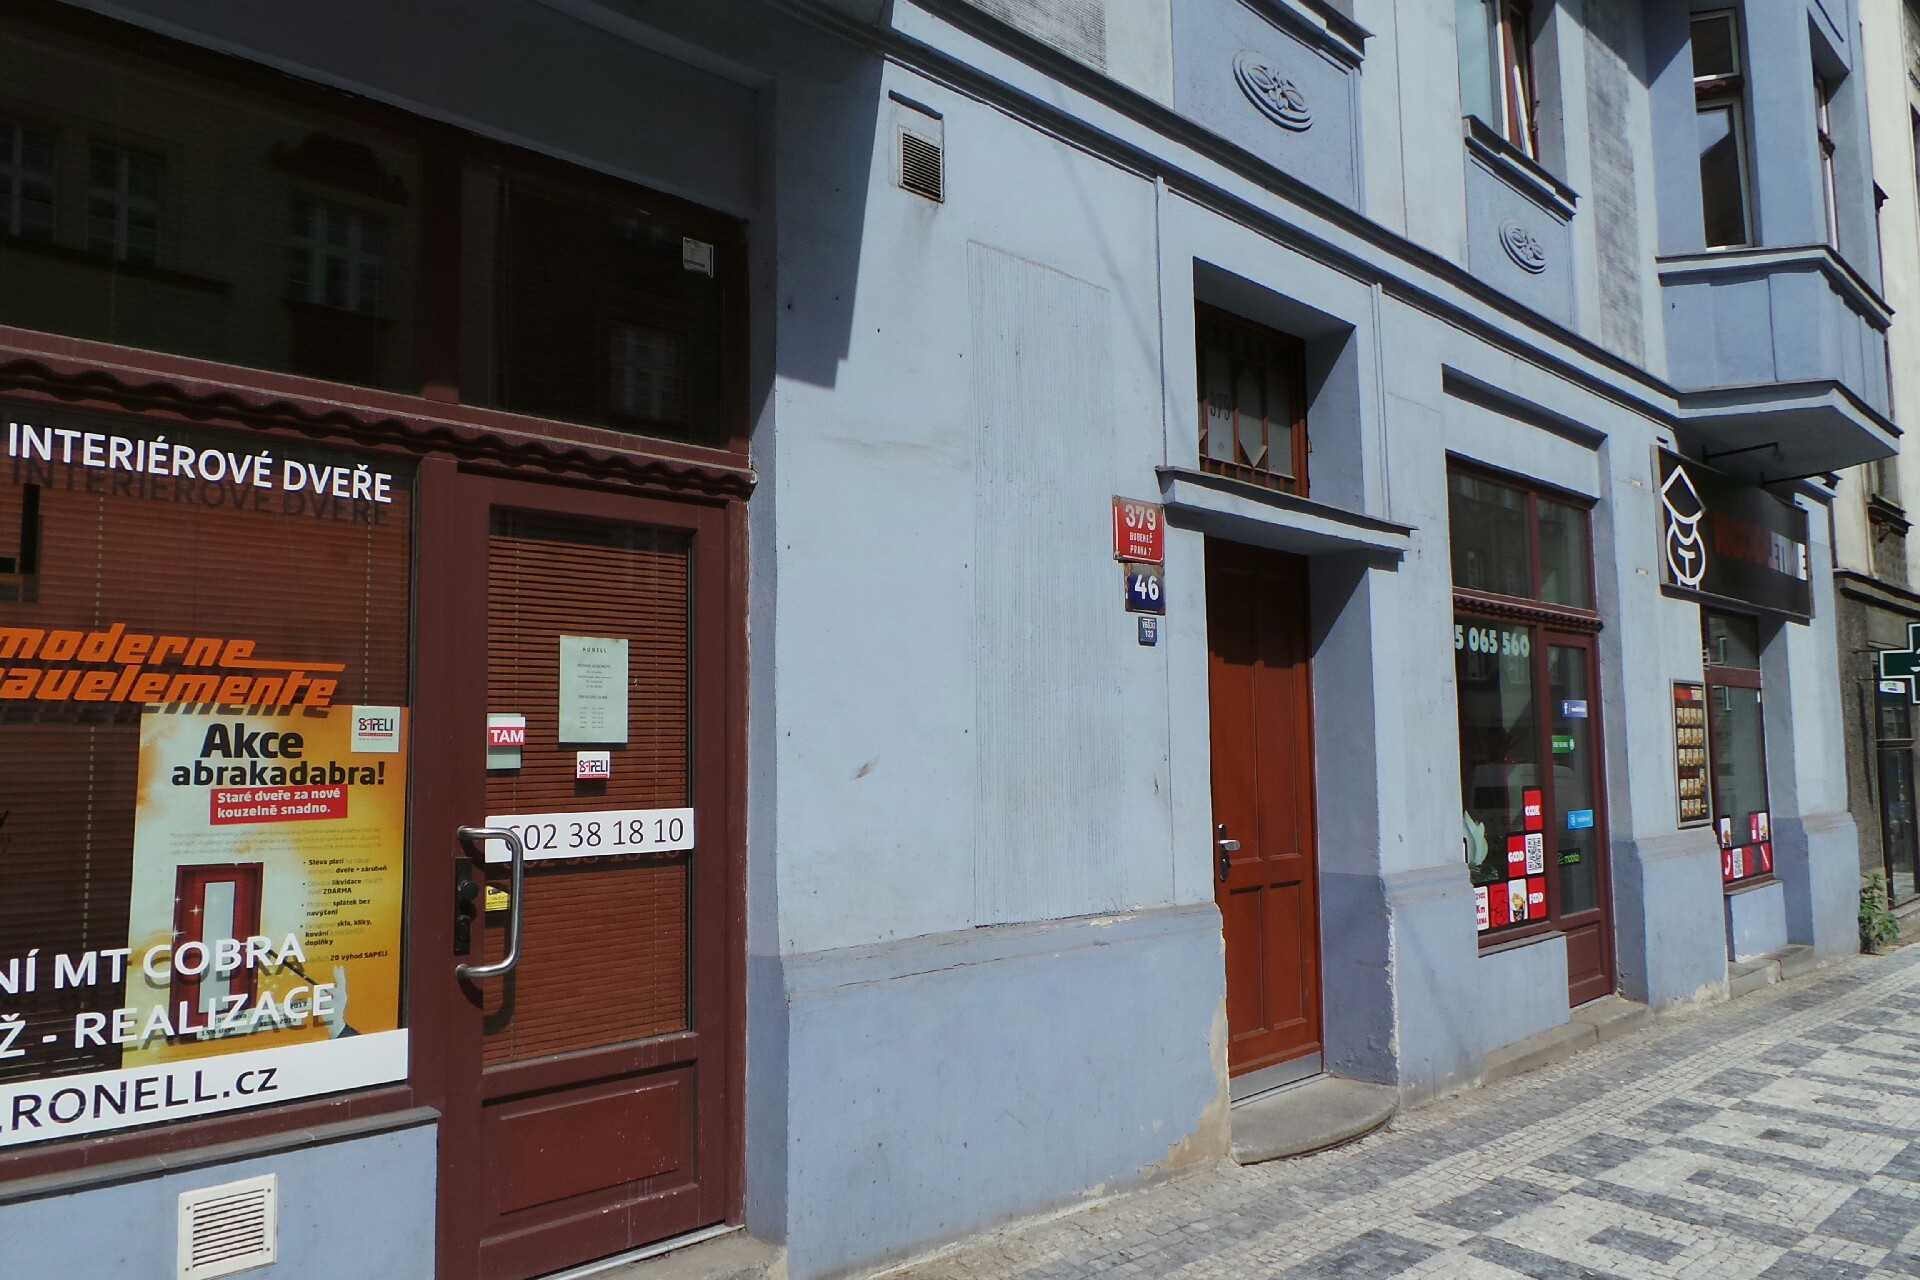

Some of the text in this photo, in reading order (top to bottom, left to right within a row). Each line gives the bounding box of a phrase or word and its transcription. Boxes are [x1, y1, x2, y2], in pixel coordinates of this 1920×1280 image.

[9, 422, 392, 503] INTERIÉROVÉ DVEŘE
[1125, 504, 1156, 531] 379
[1130, 545, 1152, 556] PRAHA 7
[1134, 575, 1159, 601] 46
[0, 622, 345, 672] moderne
[1469, 626, 1498, 654] 065
[1502, 631, 1530, 658] 560
[0, 664, 337, 706] auelemente
[359, 718, 393, 731] SAPELI
[490, 729, 524, 743] TAM
[200, 723, 304, 759] Akce
[171, 760, 385, 786] abrakadabra!
[579, 760, 608, 773] SAPELI
[217, 787, 341, 803] Staré dveře za nové
[217, 802, 331, 818] kouzelně snadno.
[569, 821, 601, 848] 38
[613, 819, 644, 846] 18
[654, 817, 684, 843] 10
[306, 909, 338, 917] navýšení
[333, 899, 357, 907] splátek
[55, 948, 132, 989] MT
[143, 932, 306, 980] COBRA
[364, 951, 388, 959] SAPELI
[75, 983, 335, 1049] REALIZACE
